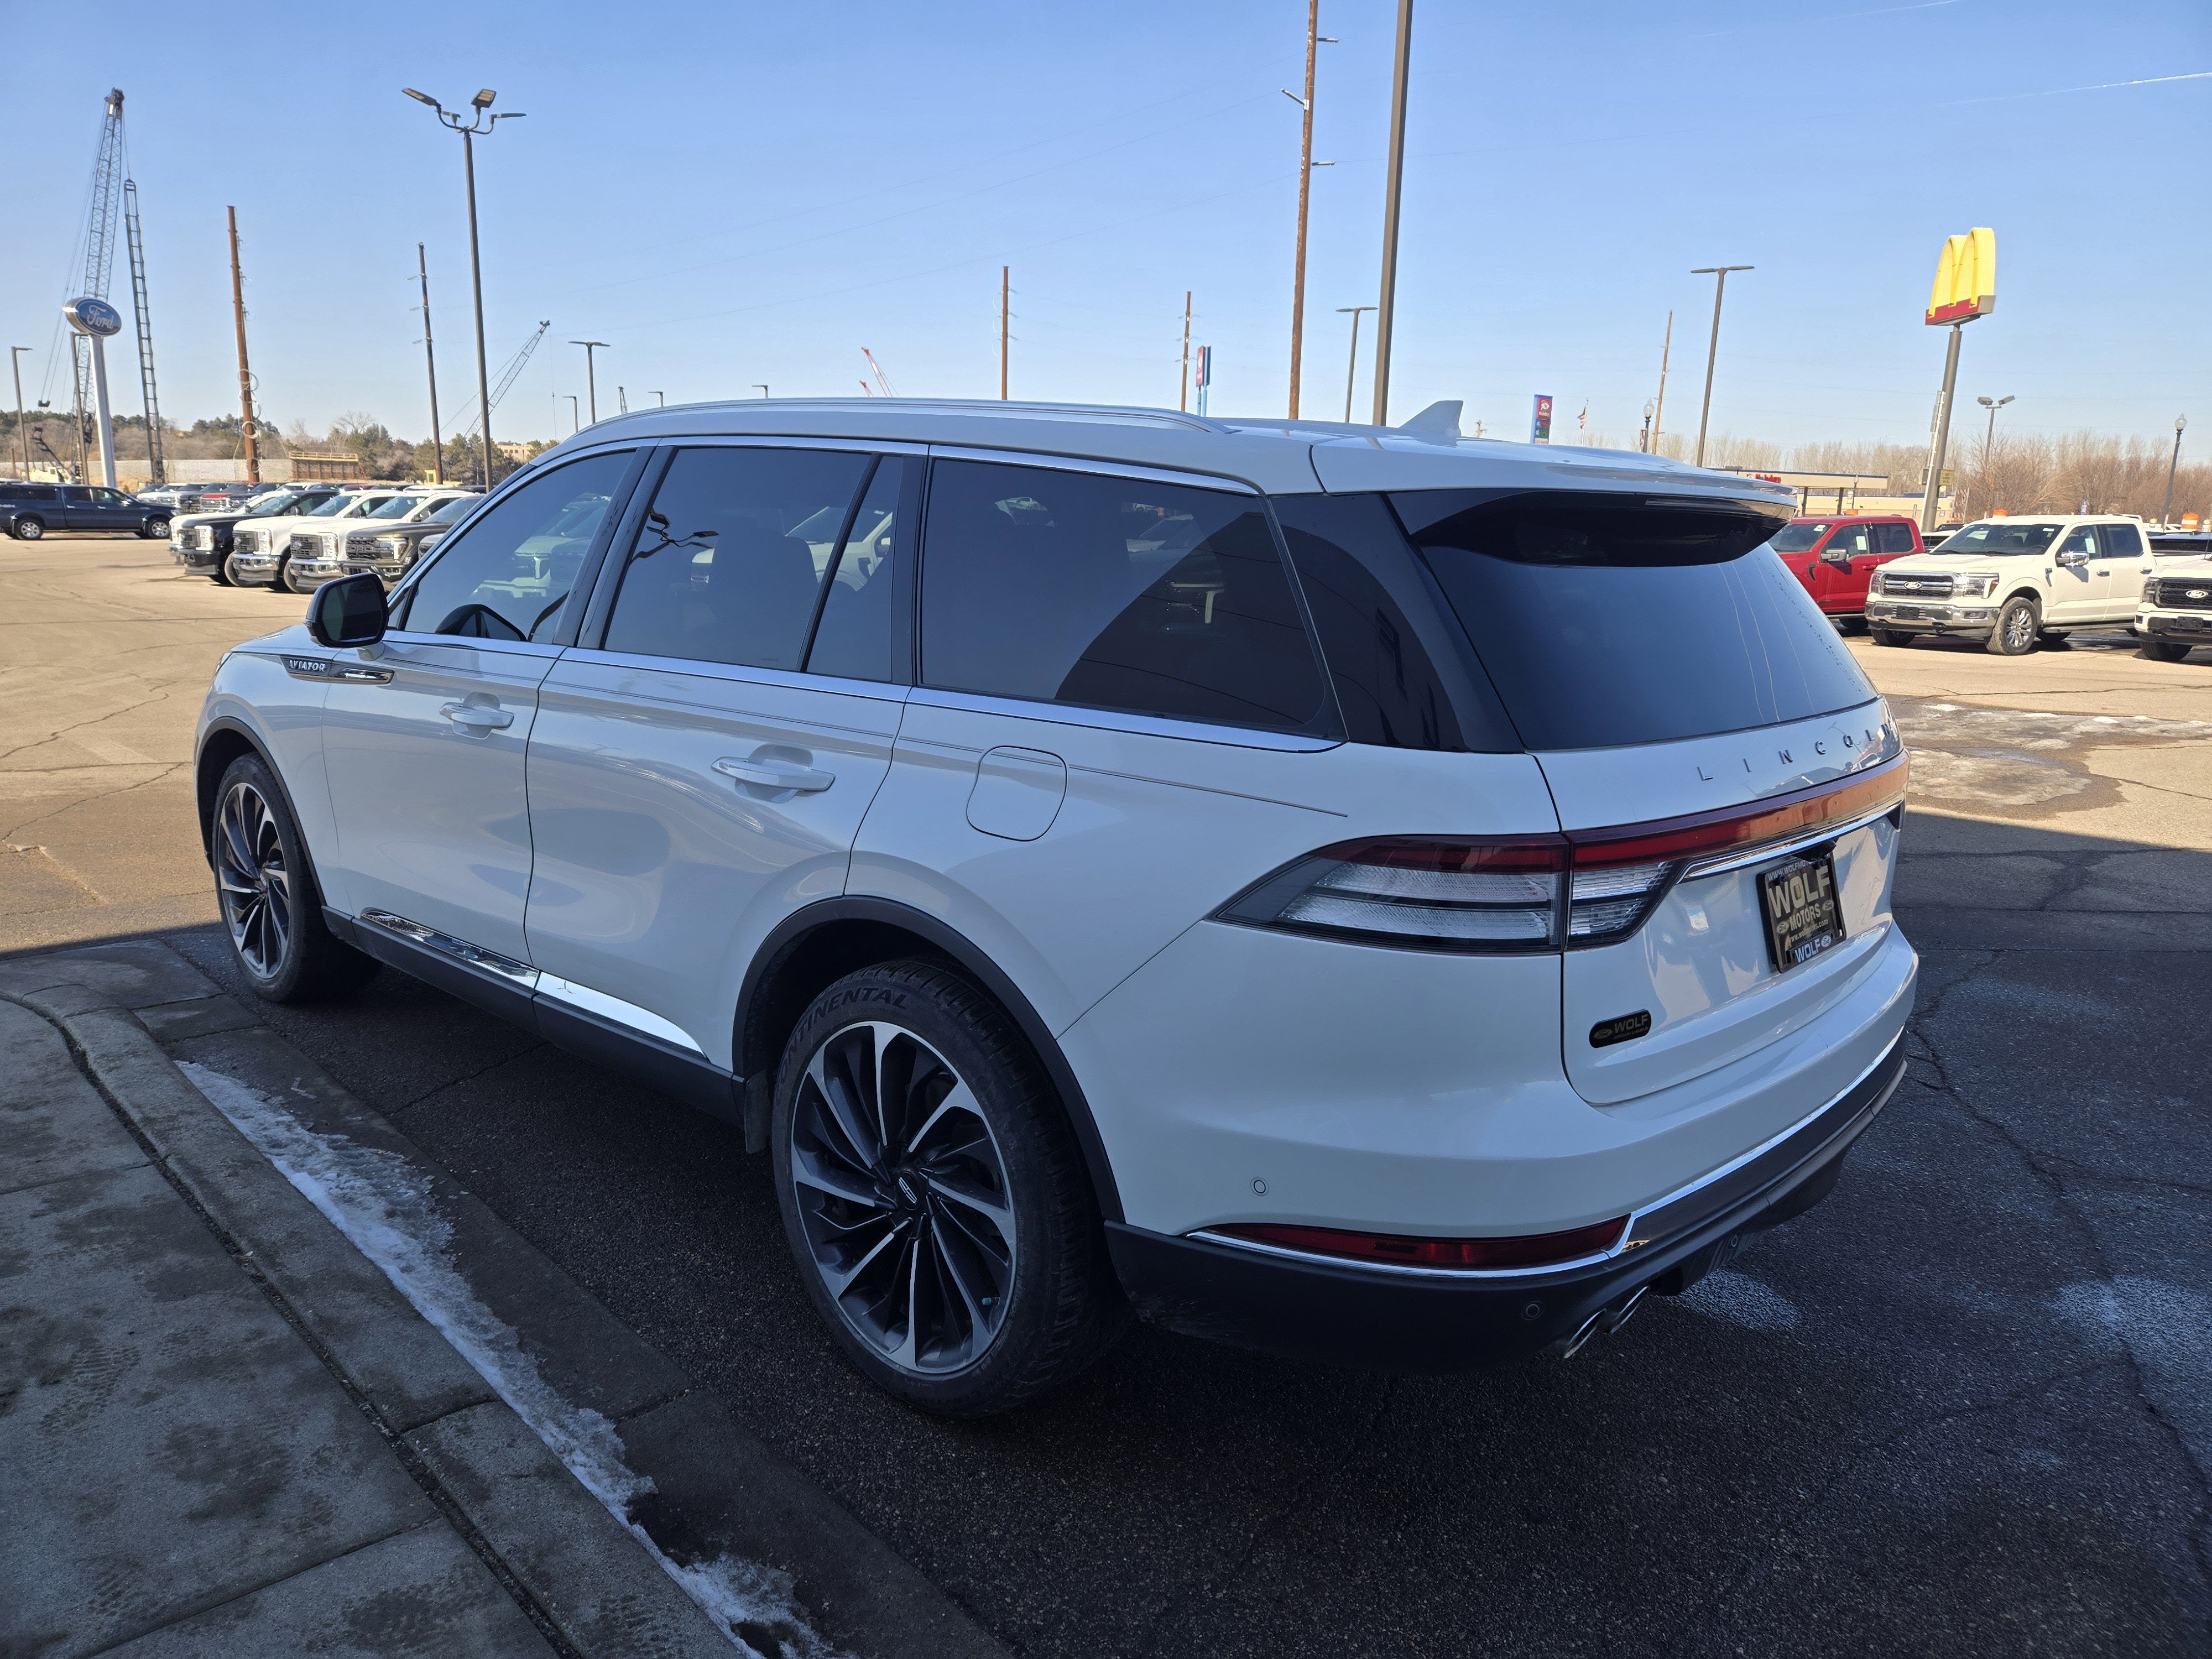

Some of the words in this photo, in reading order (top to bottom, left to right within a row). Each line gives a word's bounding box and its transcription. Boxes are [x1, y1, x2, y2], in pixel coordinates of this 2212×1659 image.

[87, 305, 114, 329] Ford
[289, 660, 326, 672] AVIATOR
[1697, 723, 1891, 781] LINCOLN
[1768, 865, 1830, 919] WOLF
[1789, 902, 1821, 931] MOTORS
[1794, 938, 1820, 963] WOLF
[1615, 1014, 1648, 1033] WOLF
